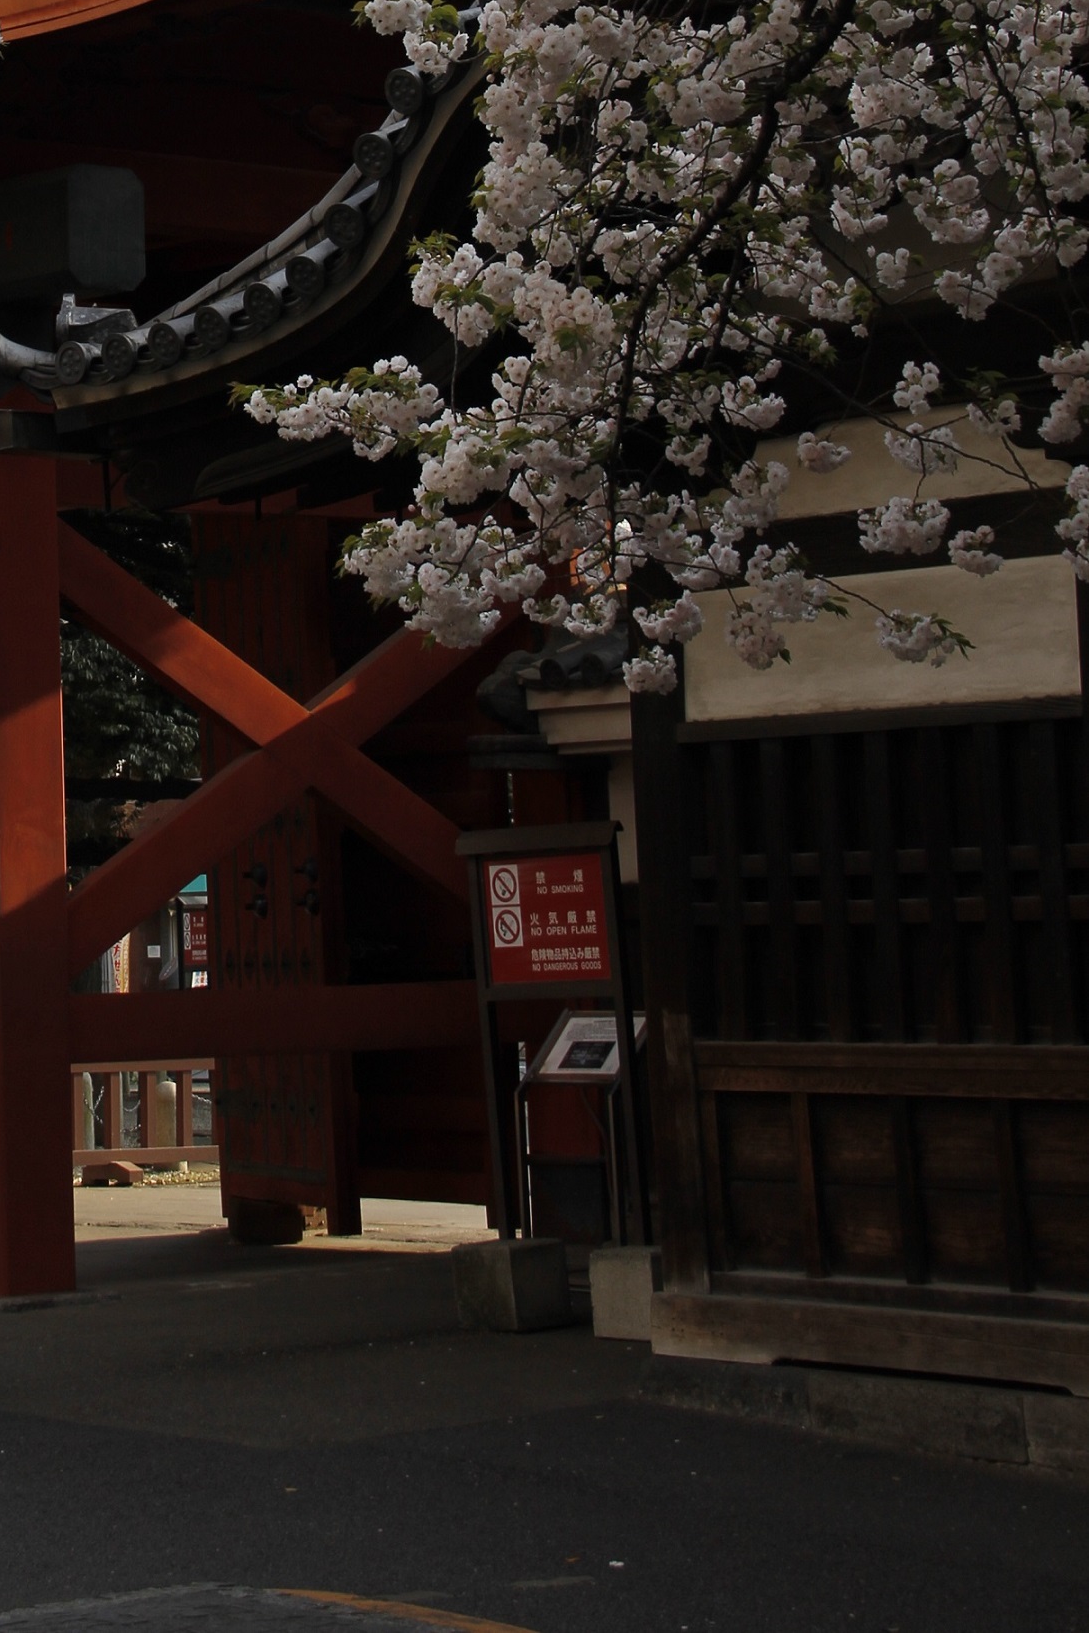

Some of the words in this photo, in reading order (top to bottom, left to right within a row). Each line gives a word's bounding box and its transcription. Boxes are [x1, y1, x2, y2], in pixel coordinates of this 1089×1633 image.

[535, 869, 584, 884] 禁煙
[537, 886, 548, 895] NO
[551, 884, 584, 894] SMOKING
[530, 910, 597, 926] 火気厳禁
[530, 927, 543, 936] NO
[546, 926, 567, 936] OPEN
[571, 924, 597, 935] FLAME
[532, 963, 541, 972] NO
[543, 962, 579, 971] DANGEROUS
[581, 961, 602, 970] GOODS
